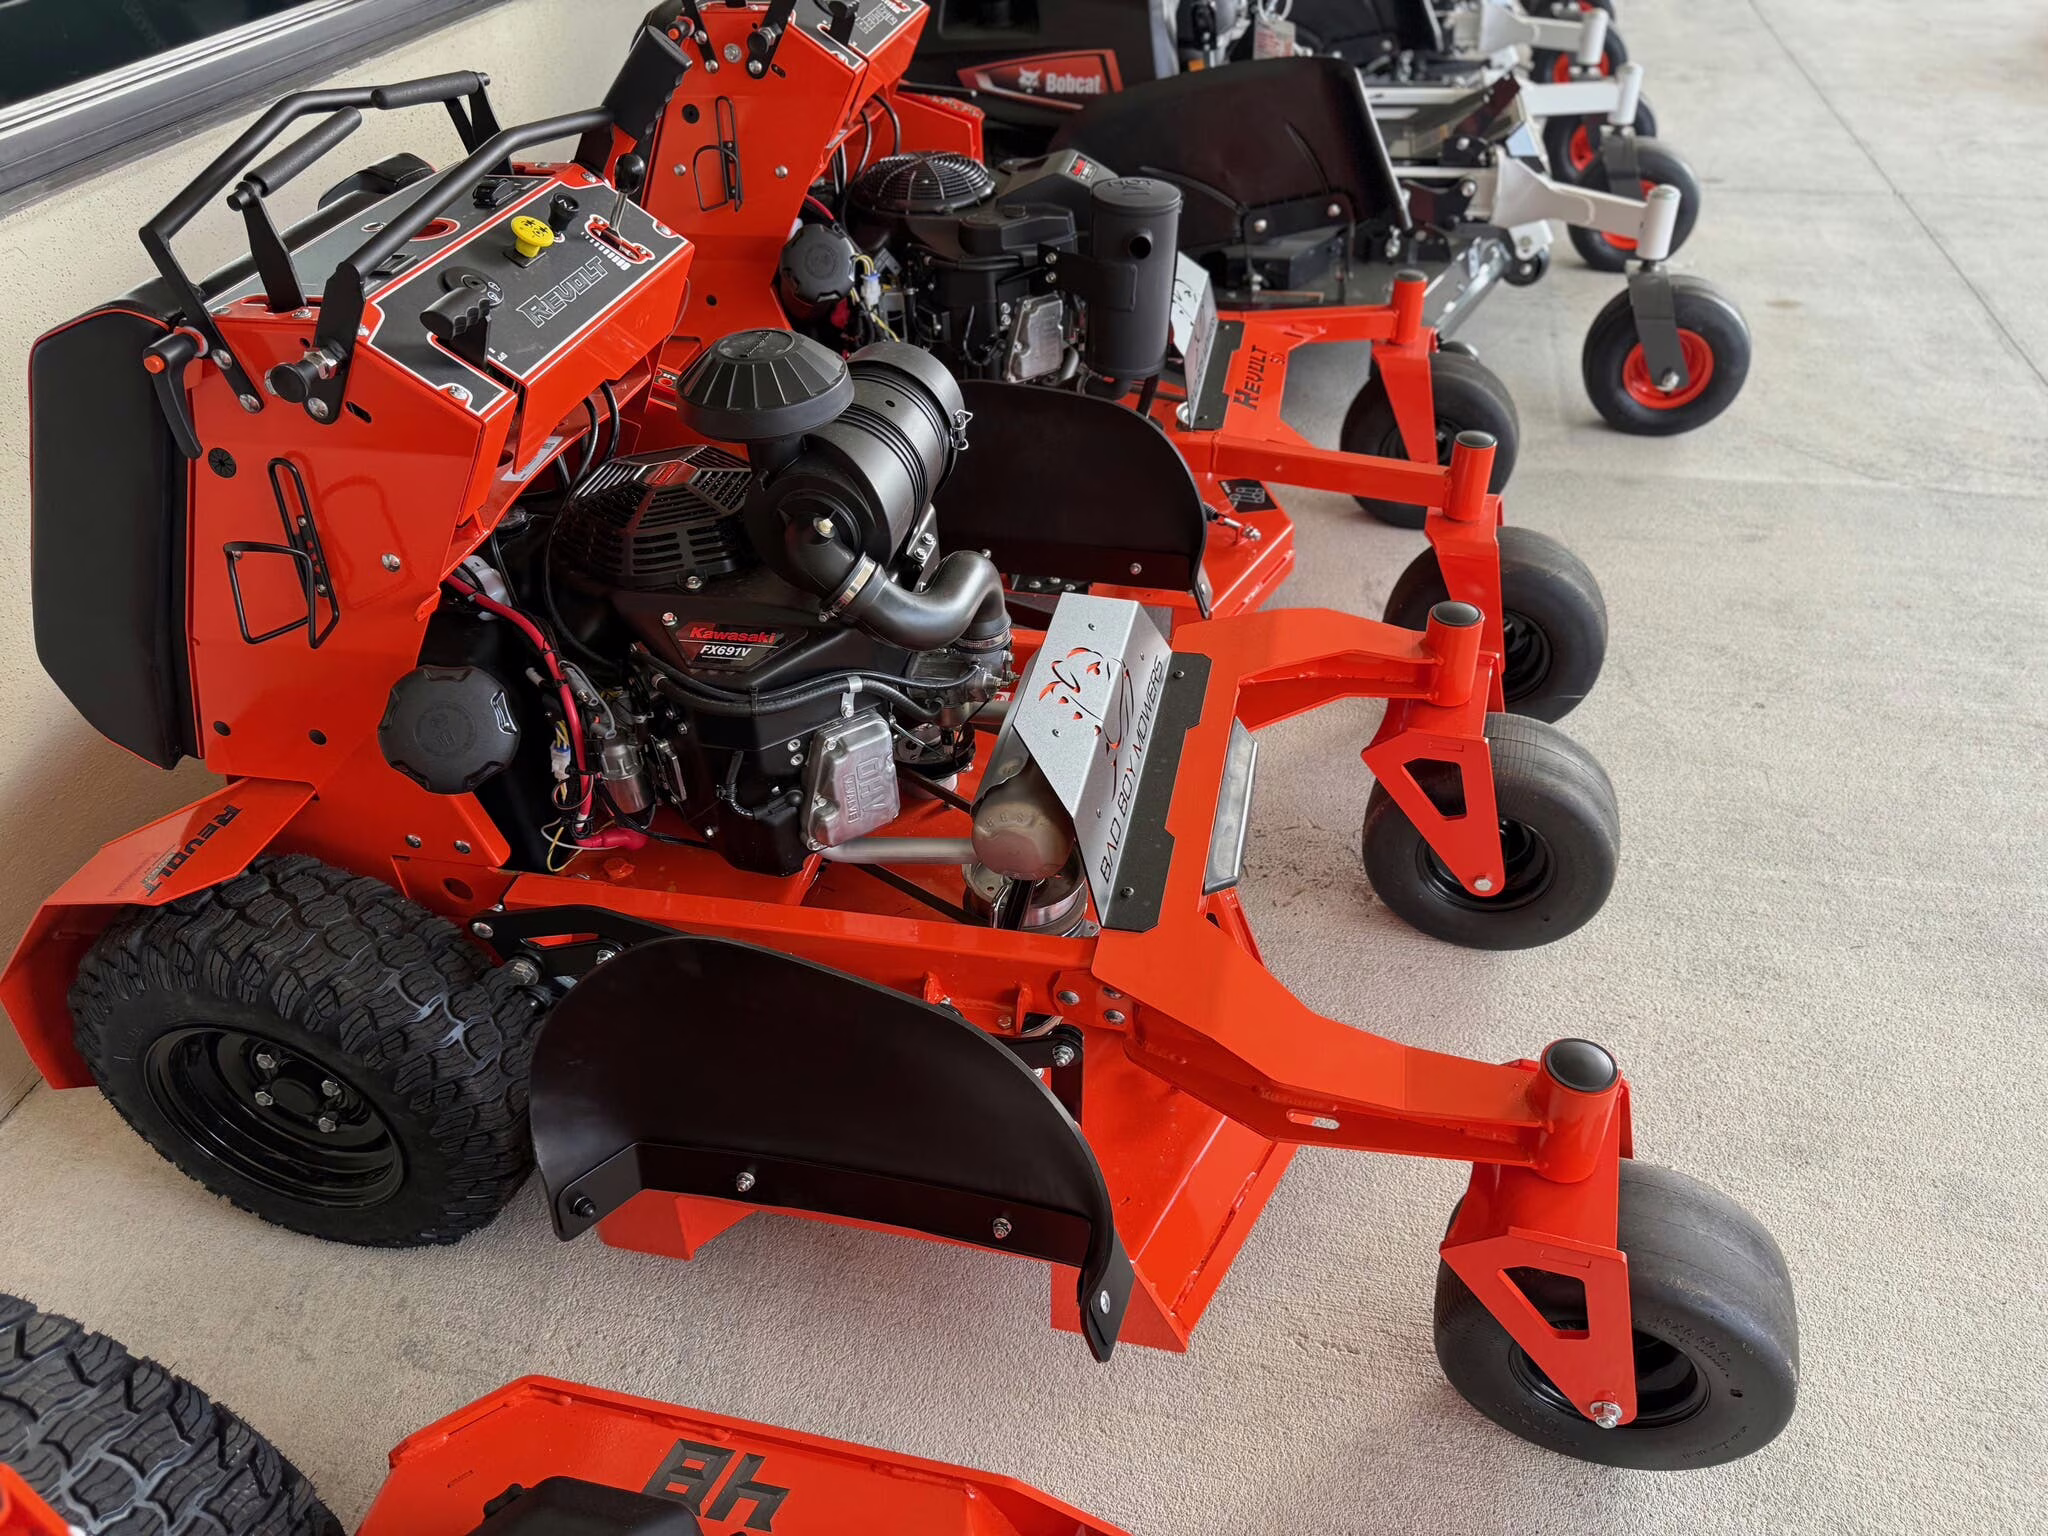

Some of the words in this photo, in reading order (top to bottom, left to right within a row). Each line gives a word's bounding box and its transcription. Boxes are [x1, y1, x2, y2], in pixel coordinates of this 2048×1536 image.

[1045, 73, 1101, 95] Bobcat
[689, 627, 777, 644] Kawasaki
[700, 645, 752, 657] FX691V
[1100, 817, 1122, 884] BAD
[1117, 754, 1136, 818] BOY
[1132, 655, 1164, 760] MOWERS
[642, 1438, 791, 1532] 48
